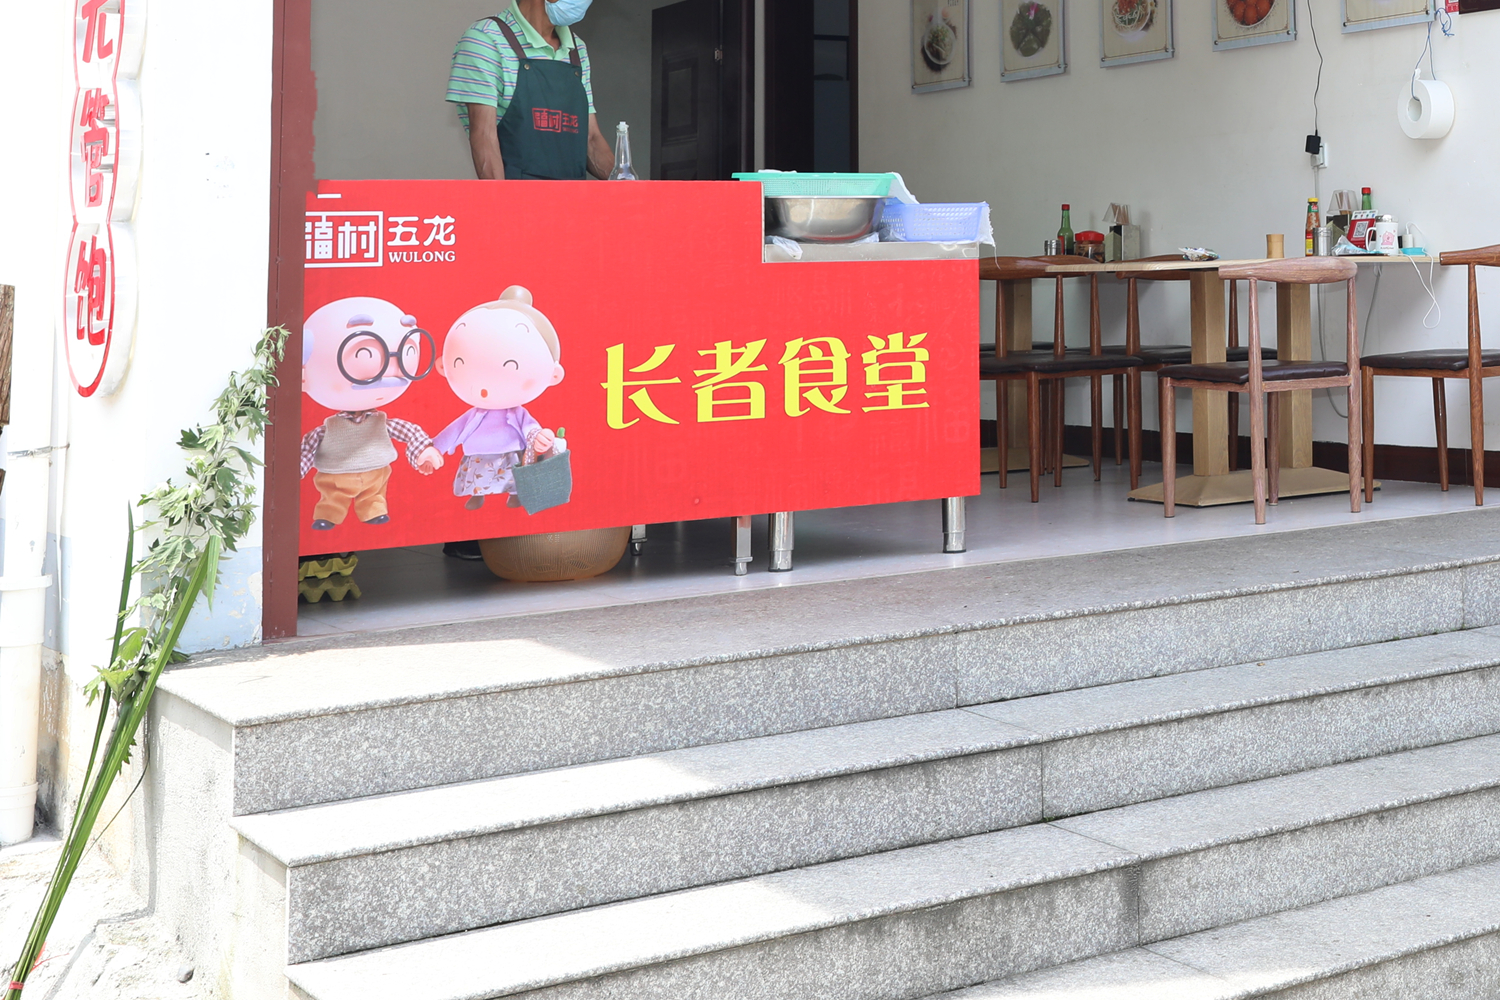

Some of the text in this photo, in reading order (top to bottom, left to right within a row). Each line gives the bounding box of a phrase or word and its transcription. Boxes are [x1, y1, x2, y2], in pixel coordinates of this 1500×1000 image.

[387, 214, 457, 247] 五龙
[388, 250, 457, 264] WULONG
[599, 331, 931, 430] 长者食堂
